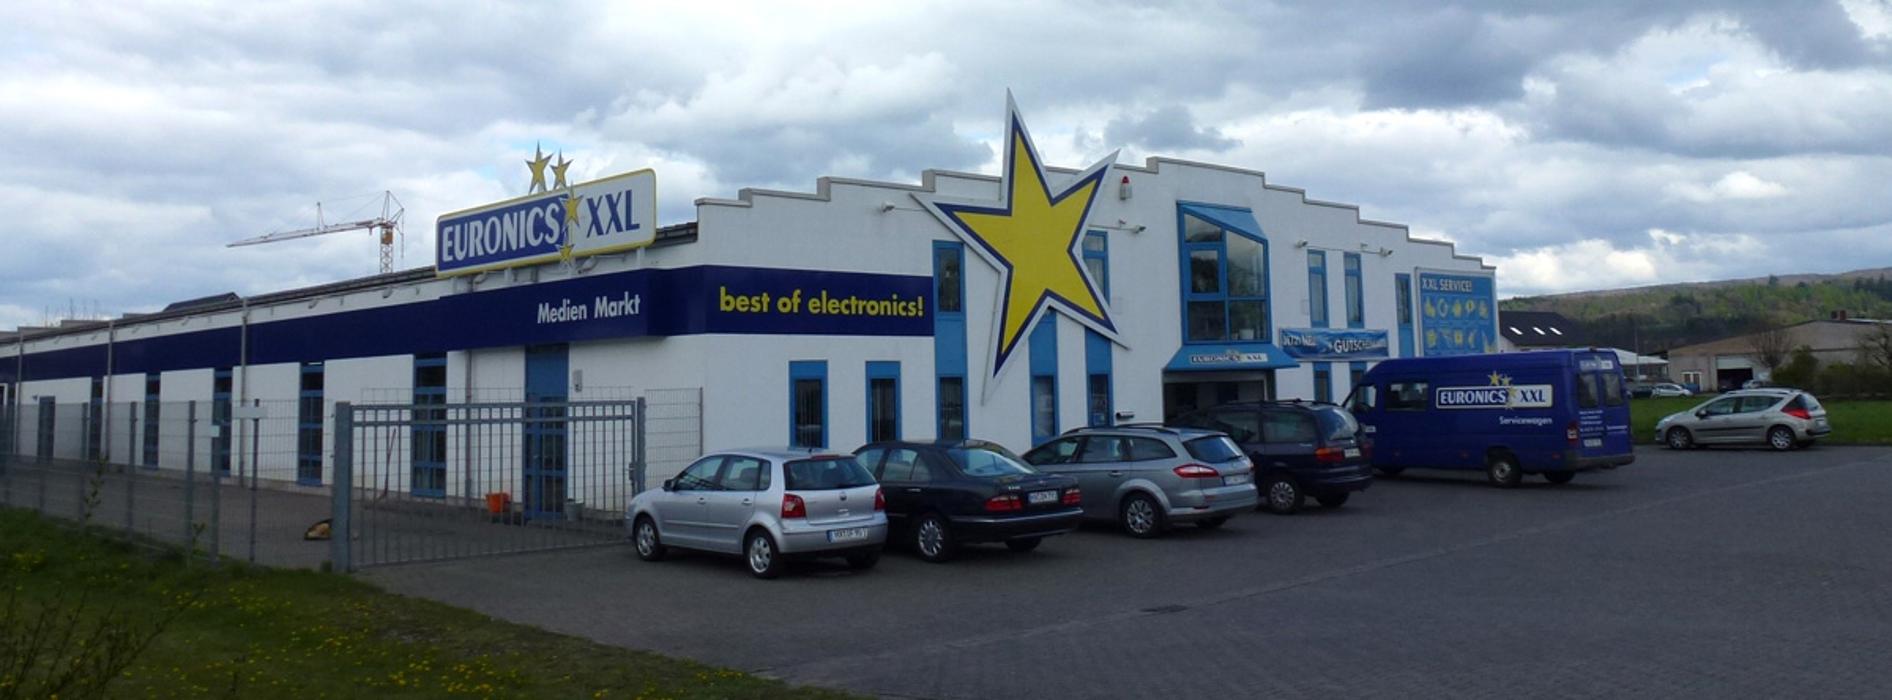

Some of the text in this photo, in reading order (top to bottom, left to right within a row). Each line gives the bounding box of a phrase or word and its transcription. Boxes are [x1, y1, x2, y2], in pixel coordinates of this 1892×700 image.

[442, 189, 640, 262] EURONICS XXL
[1422, 278, 1438, 290] XXL
[537, 291, 641, 324] Medien Markt
[719, 286, 924, 316] best of electronics!
[1440, 389, 1546, 404] EURONICS XXL
[1499, 416, 1553, 426] Servicewagen
